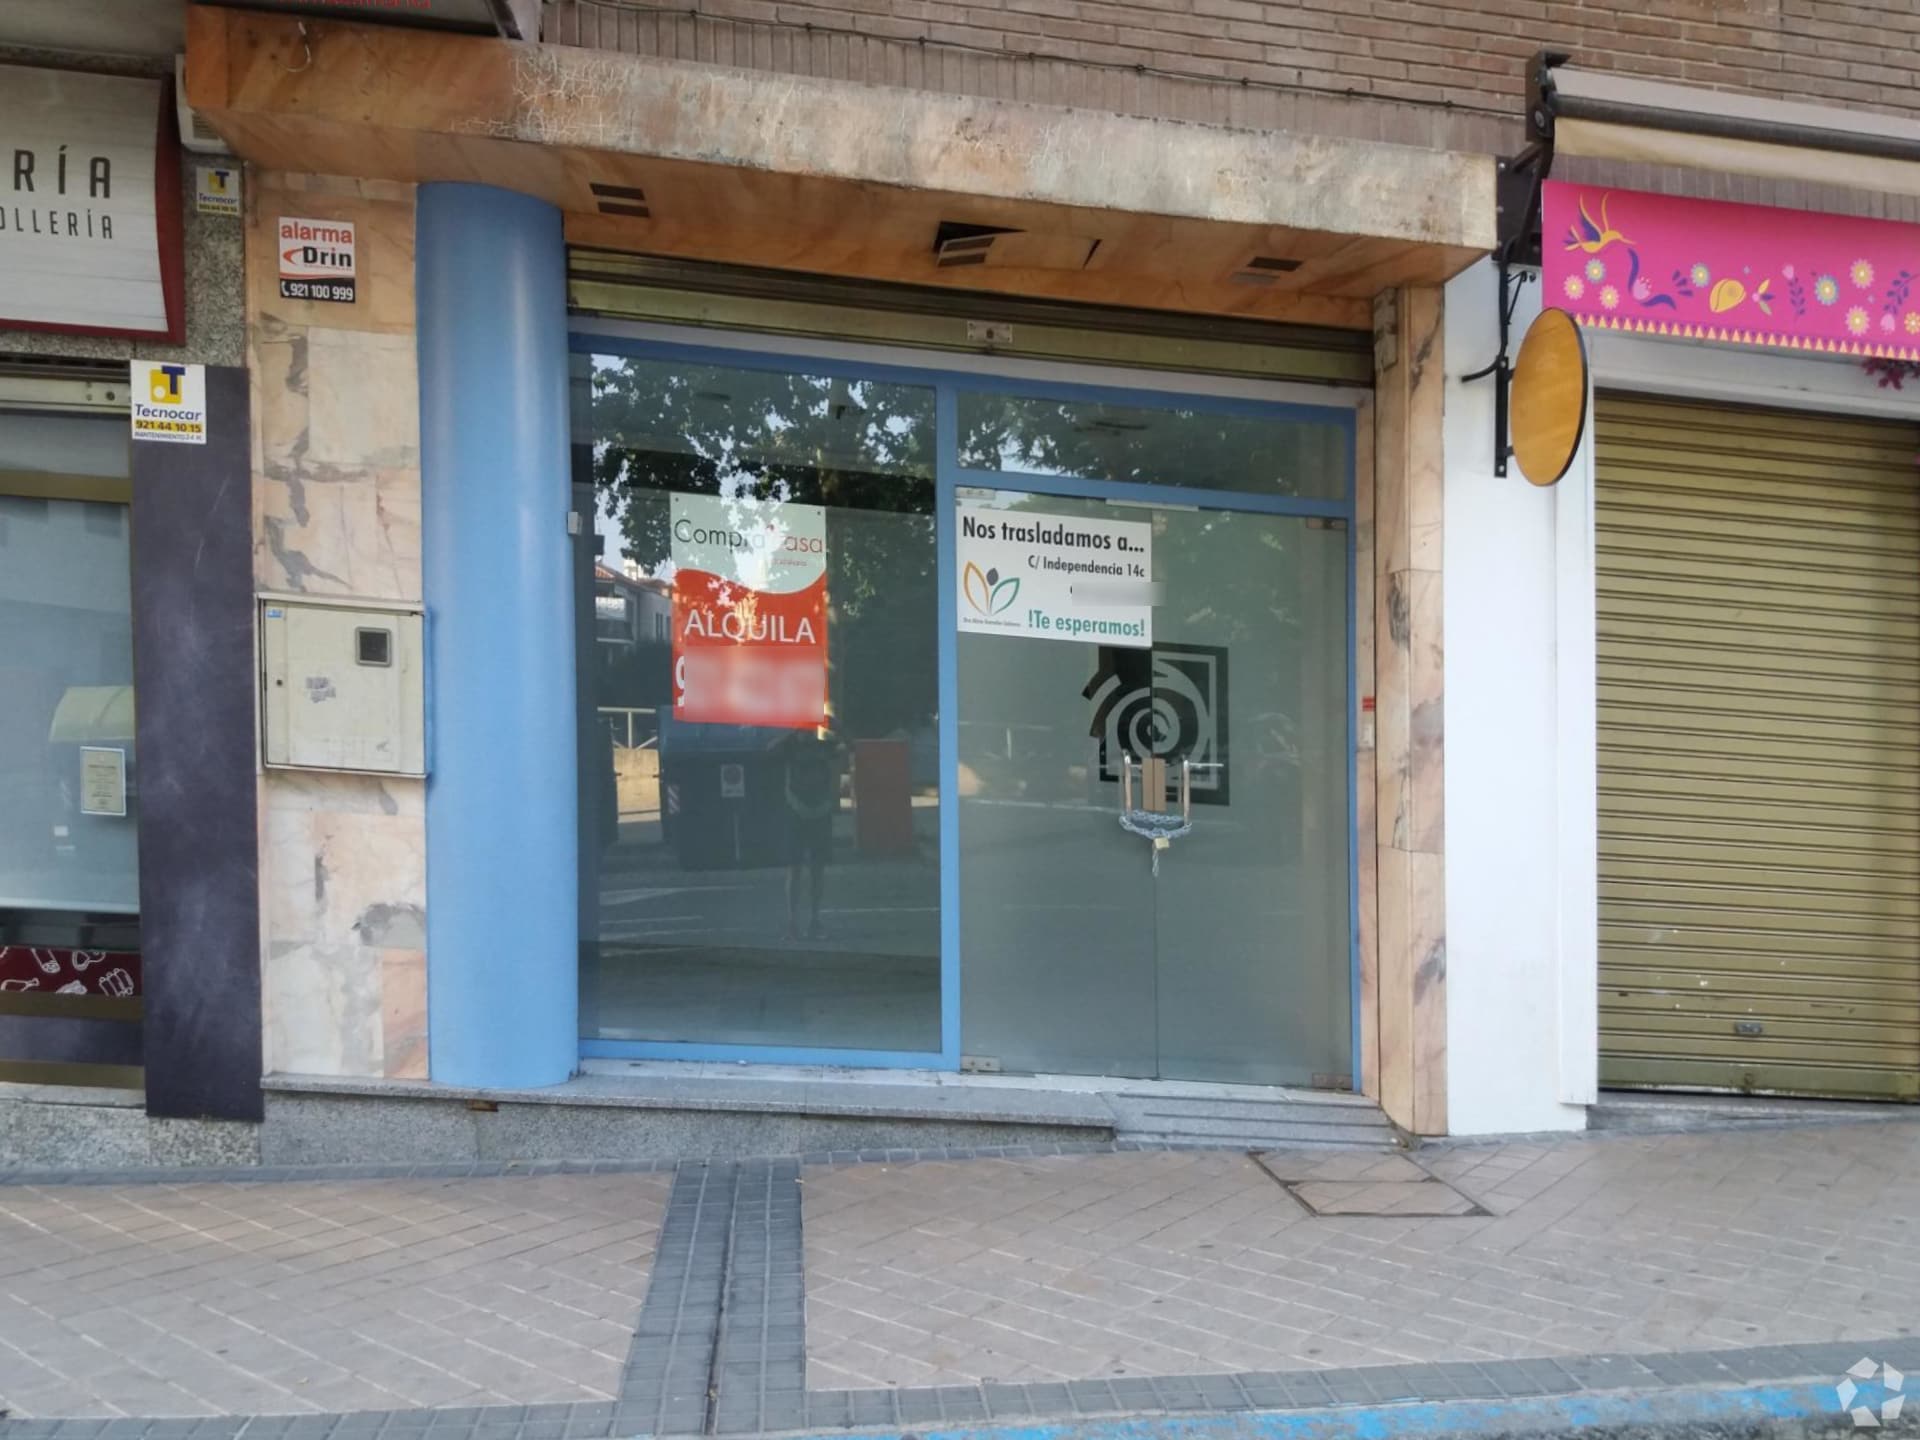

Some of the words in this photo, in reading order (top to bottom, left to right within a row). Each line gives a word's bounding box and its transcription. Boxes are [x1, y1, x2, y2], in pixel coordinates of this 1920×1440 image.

[14, 144, 111, 199] RÍA
[281, 221, 352, 244] alarma
[303, 246, 352, 267] Drin
[290, 283, 309, 297] 921
[311, 285, 329, 298] 100
[332, 286, 353, 300] 999
[162, 365, 186, 395] T
[135, 403, 202, 420] Tecnocar
[136, 420, 155, 429] 921
[158, 421, 172, 431] 44
[175, 422, 187, 432] 10
[190, 423, 202, 433] 15
[963, 515, 996, 540] Nos
[1001, 521, 1111, 550] trasladamos
[1117, 536, 1145, 553] a...
[1028, 555, 1041, 570] C/
[1043, 556, 1123, 576] Independencia
[1127, 563, 1145, 578] 14c
[684, 609, 816, 644] ALQUILA
[1028, 609, 1050, 629] !Te
[1055, 616, 1145, 637] esperamos!
